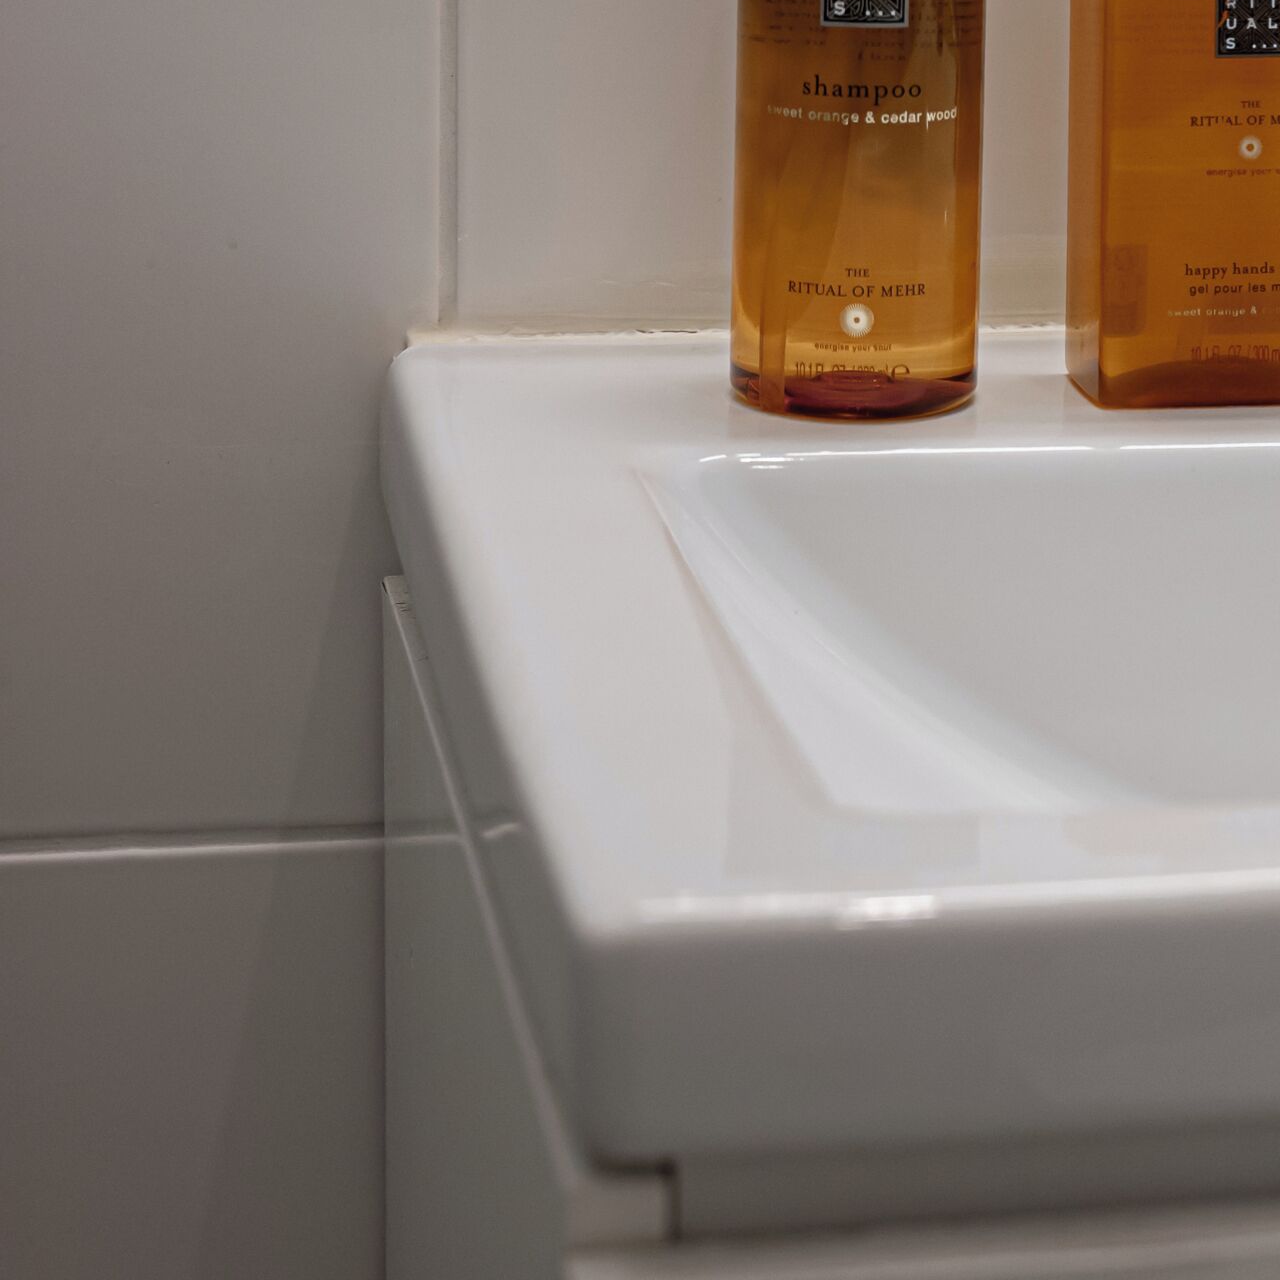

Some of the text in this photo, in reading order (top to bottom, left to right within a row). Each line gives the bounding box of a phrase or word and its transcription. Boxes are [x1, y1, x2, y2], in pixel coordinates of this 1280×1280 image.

[801, 74, 922, 106] shampoo
[1240, 100, 1261, 109] THE
[808, 108, 860, 125] orange
[865, 111, 876, 124] &
[881, 110, 922, 124] cedar
[926, 104, 958, 124] wood
[1246, 114, 1266, 126] OF
[844, 268, 871, 278] THE
[1184, 263, 1228, 280] happy
[1232, 261, 1275, 276] hands
[788, 279, 926, 298] RITUAL OF MEHR
[1189, 283, 1208, 297] gel
[1213, 284, 1243, 296] pour
[1248, 282, 1266, 293] les
